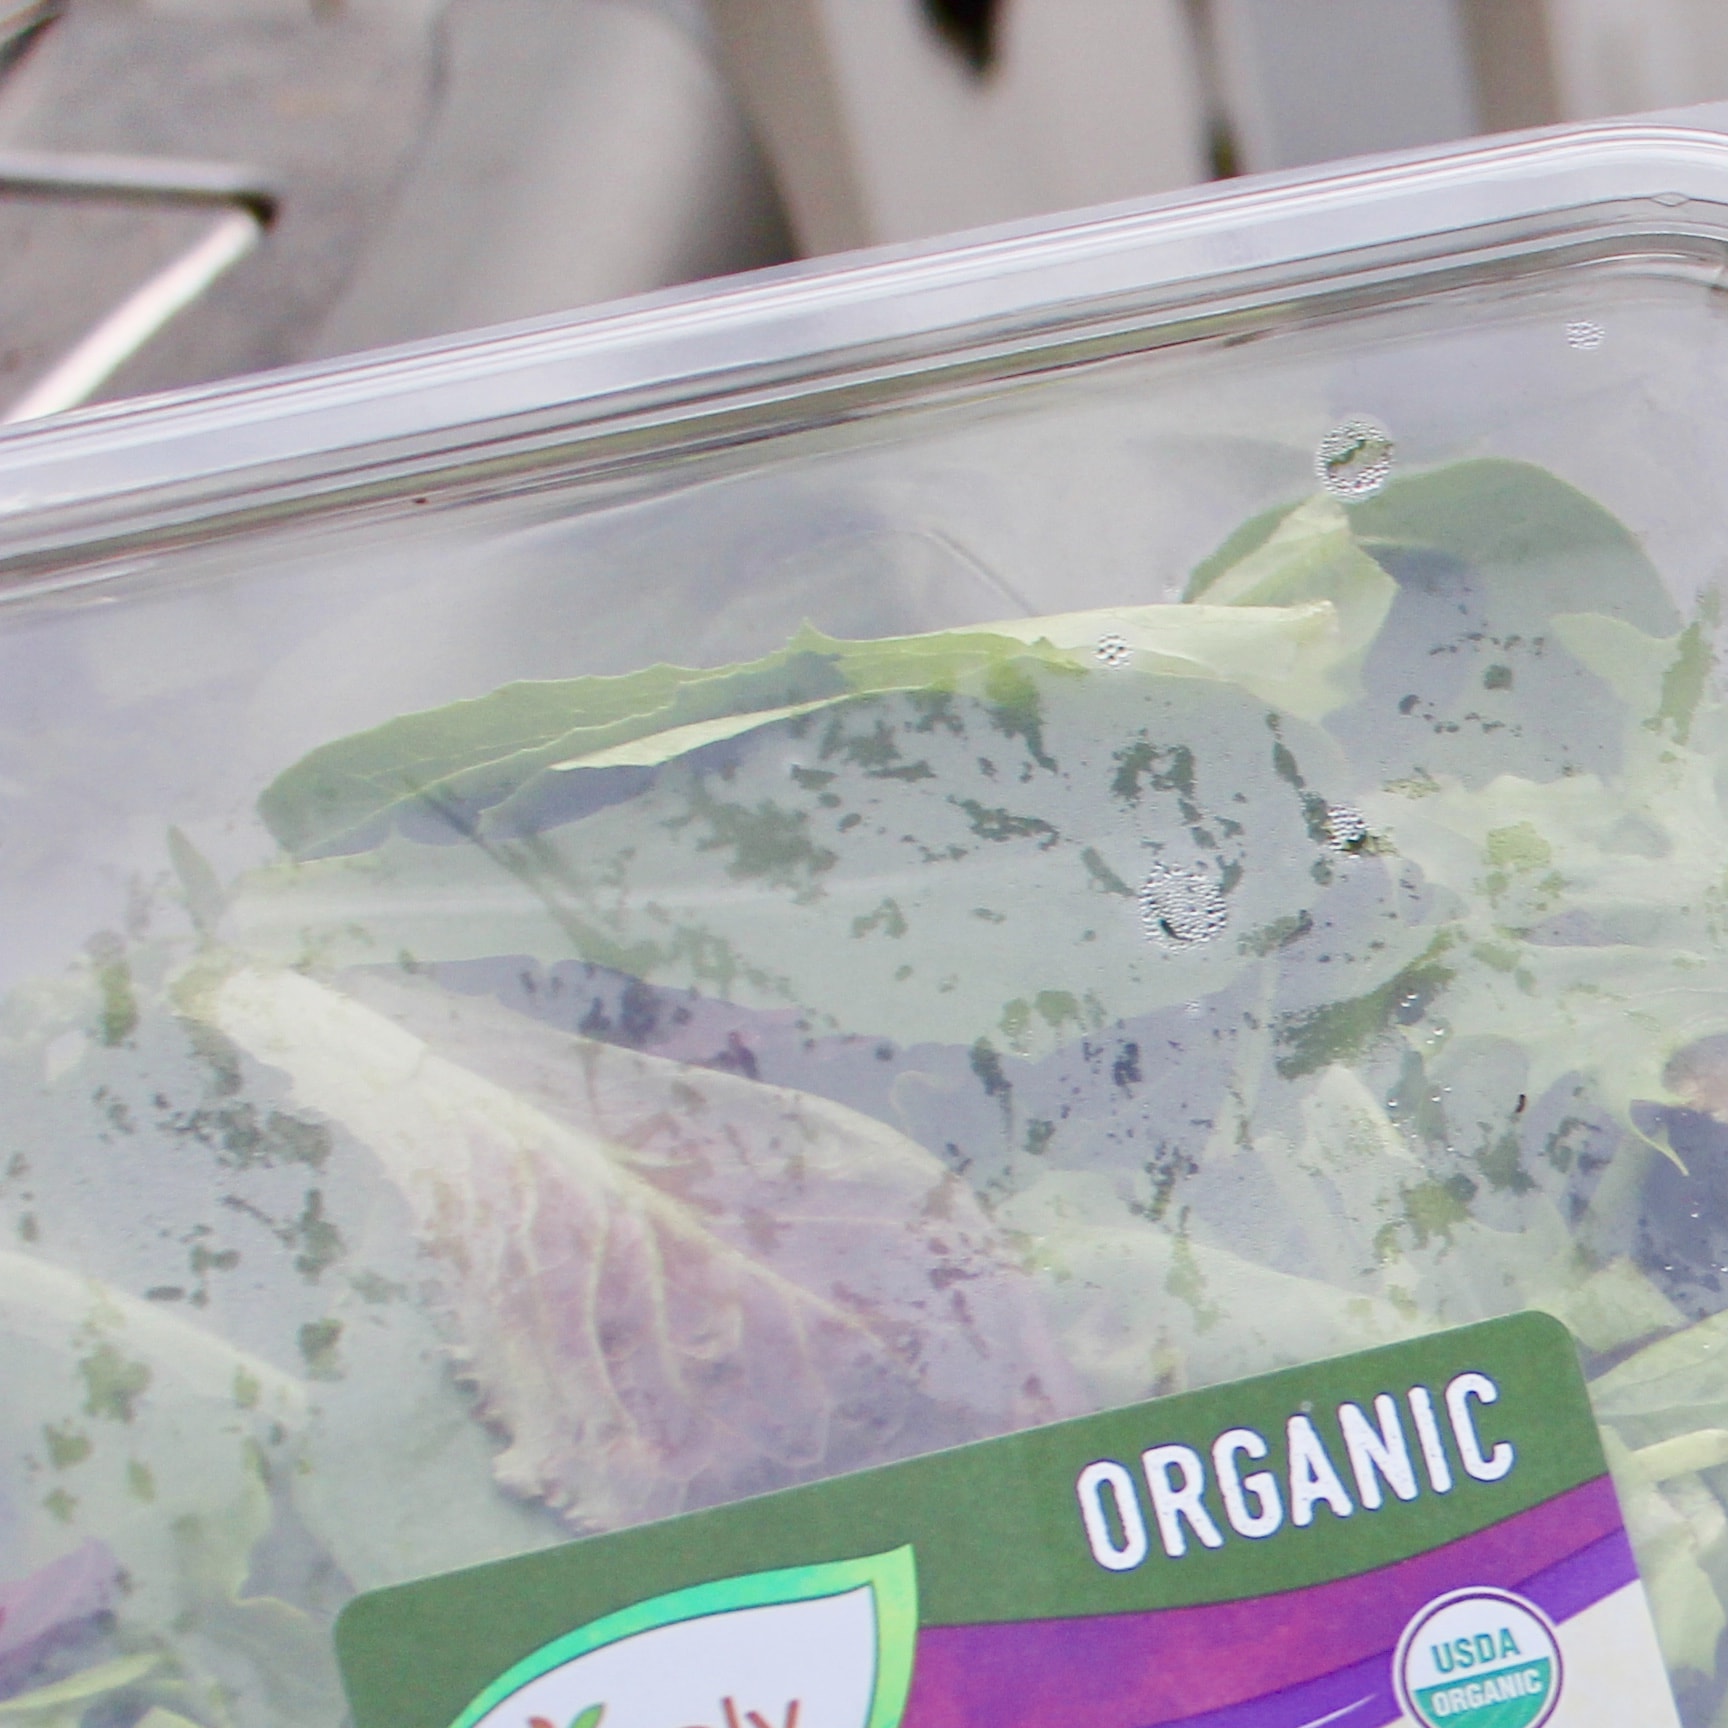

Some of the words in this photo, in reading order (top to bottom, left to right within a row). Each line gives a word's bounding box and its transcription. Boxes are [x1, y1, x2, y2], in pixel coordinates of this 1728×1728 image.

[1075, 1372, 1516, 1572] ORGANIC
[1431, 1627, 1521, 1674] USDA
[1431, 1669, 1542, 1717] ORGANIC
